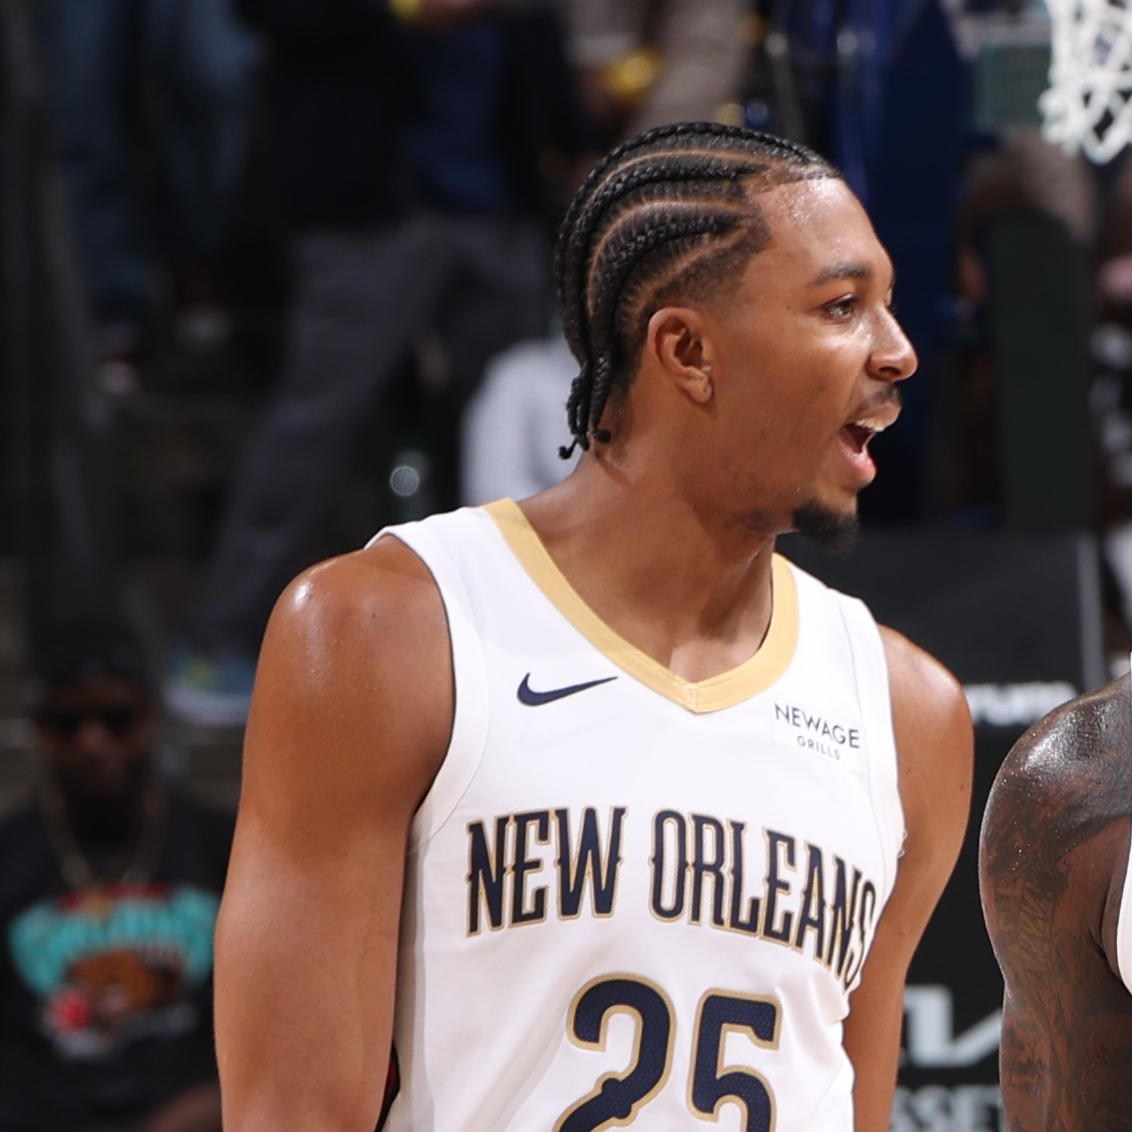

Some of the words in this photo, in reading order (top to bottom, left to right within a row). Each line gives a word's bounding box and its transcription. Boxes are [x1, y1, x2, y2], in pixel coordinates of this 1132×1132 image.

[774, 702, 860, 749] NEWAGE
[797, 735, 840, 760] GRILLS
[466, 806, 628, 937] NEW
[649, 808, 877, 995] ORLEANS
